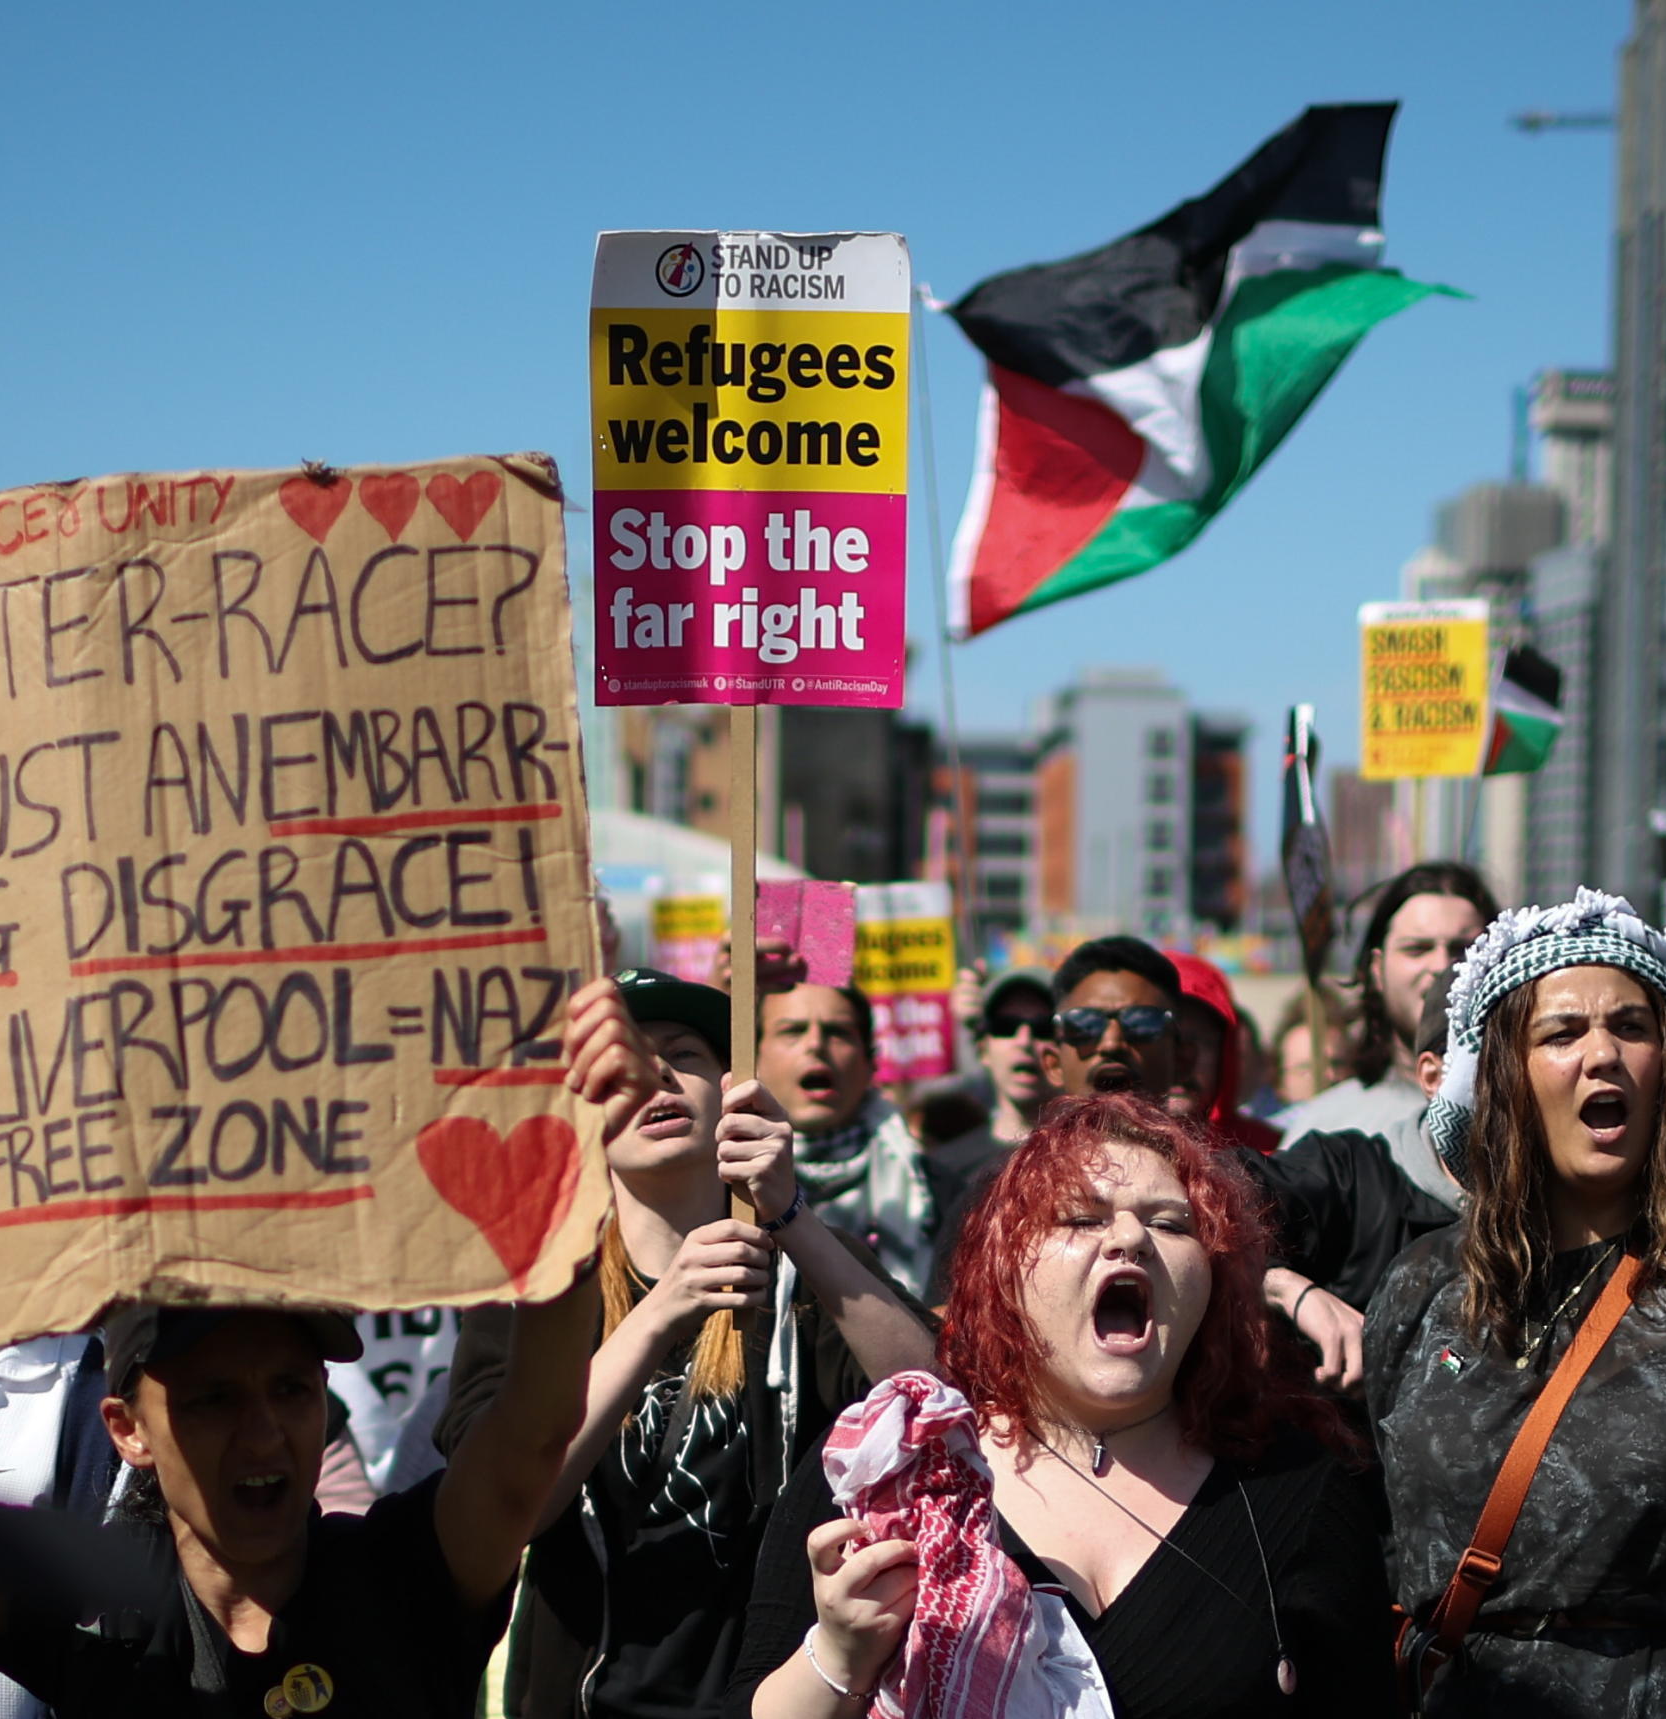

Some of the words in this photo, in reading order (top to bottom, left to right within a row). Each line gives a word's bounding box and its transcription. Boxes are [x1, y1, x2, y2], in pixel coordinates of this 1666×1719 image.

[711, 245, 790, 270] STAND
[799, 246, 833, 270] UP
[711, 273, 742, 298] TO
[749, 274, 845, 299] RACISM
[608, 323, 895, 403] Refugees
[608, 402, 880, 467] welcome
[96, 475, 234, 534] UNITY
[609, 507, 747, 586] Stop
[764, 509, 870, 573] the
[610, 587, 694, 649] far
[713, 587, 865, 664] right
[61, 830, 544, 960] DISGRACE!
[148, 1096, 371, 1188] ZONE
